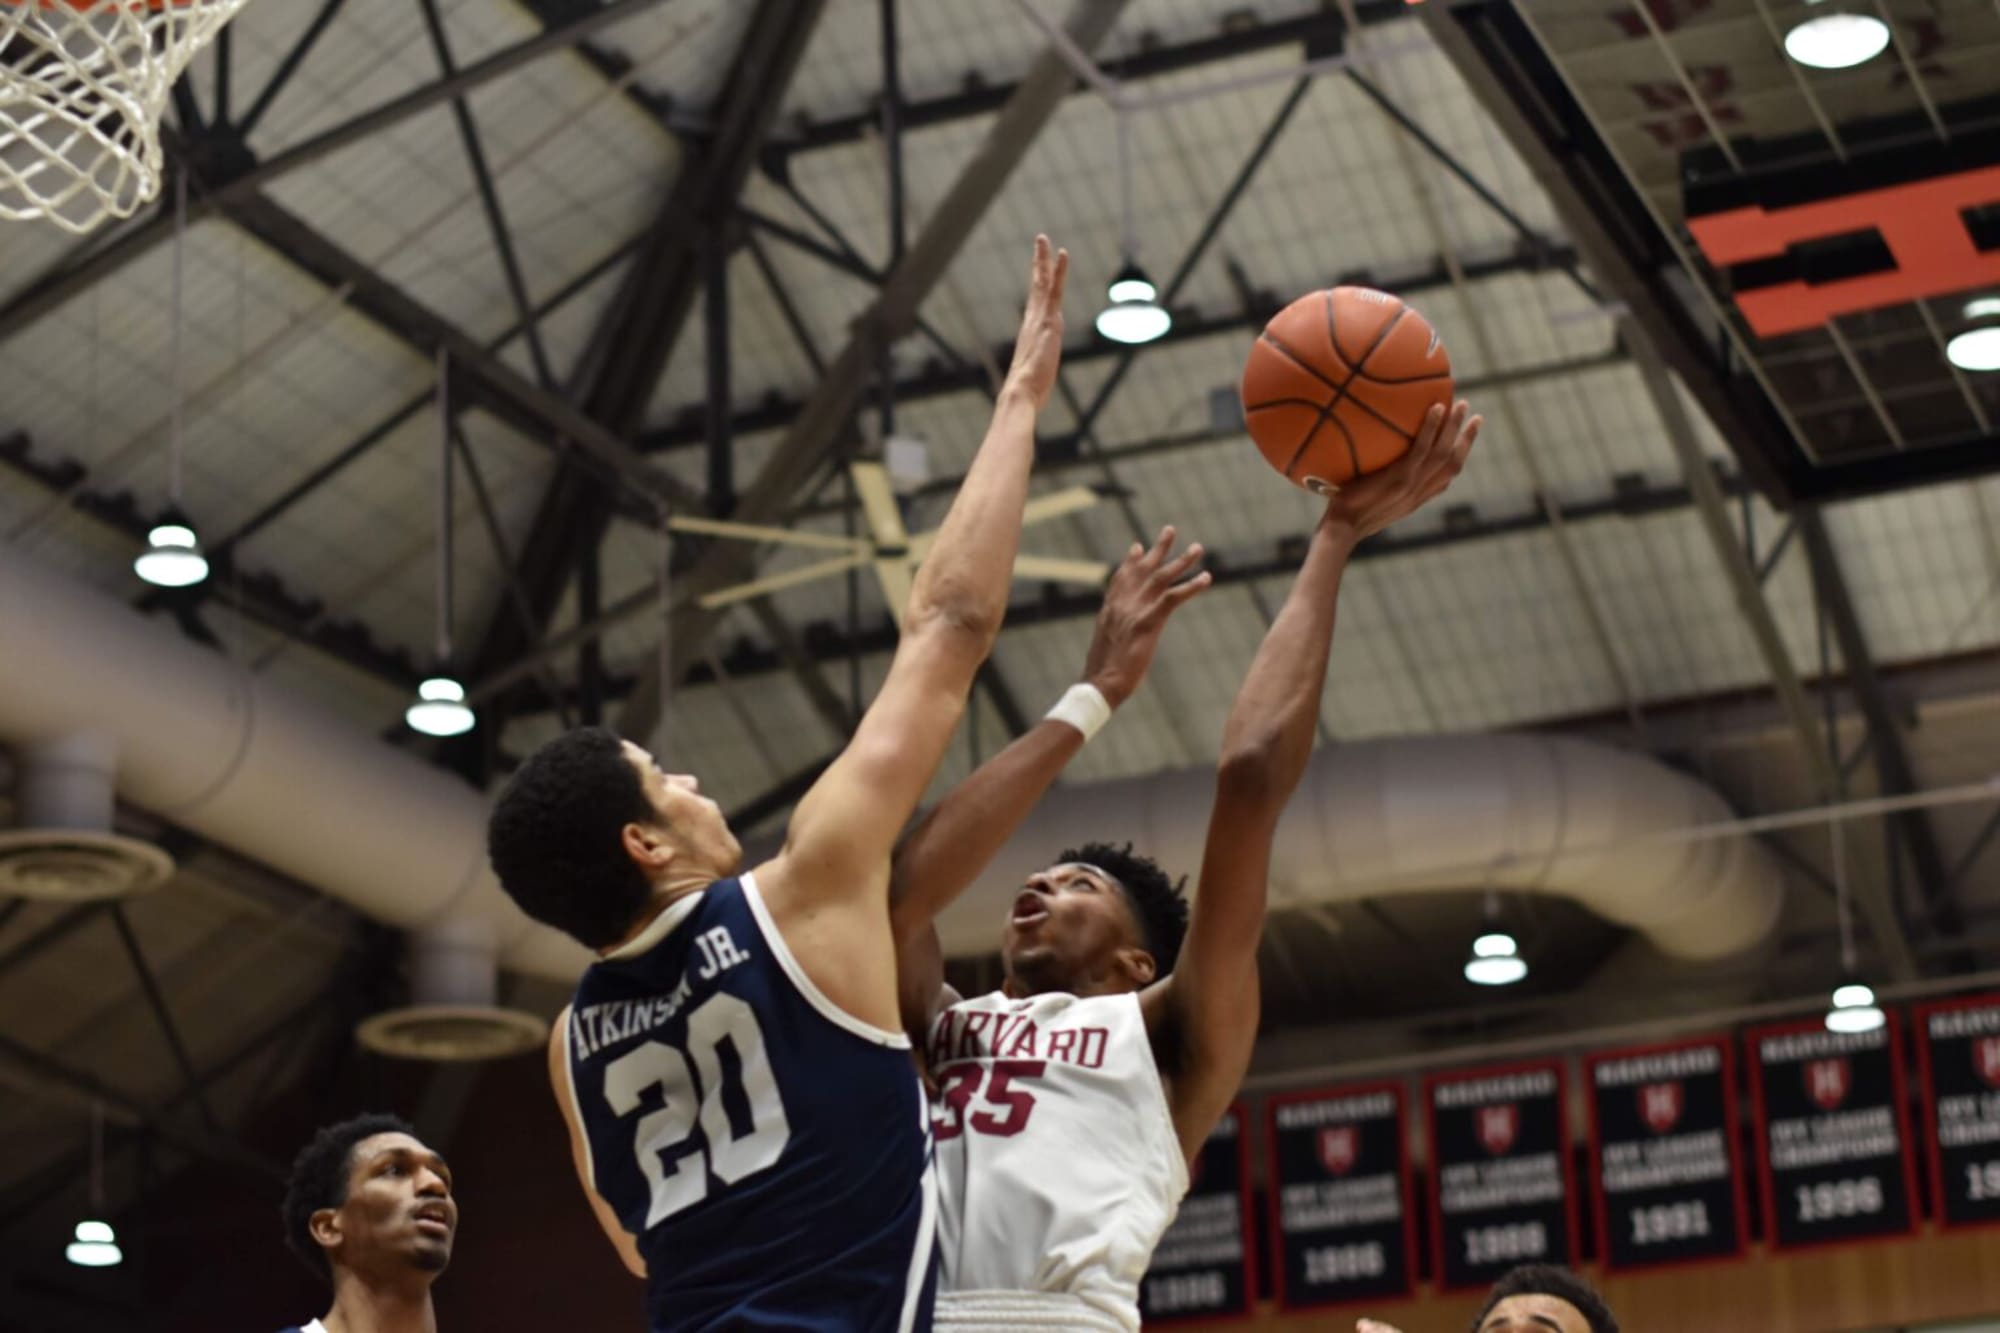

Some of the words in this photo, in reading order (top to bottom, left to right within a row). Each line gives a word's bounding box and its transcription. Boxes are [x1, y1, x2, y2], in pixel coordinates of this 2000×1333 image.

[695, 926, 749, 980] JR.
[932, 1010, 1109, 1069] ARVARD
[1762, 1030, 1884, 1061] HARVARD
[1435, 1072, 1553, 1107] HARVARD
[1597, 1050, 1718, 1084] HARVARD
[604, 992, 791, 1230] 20
[931, 1060, 1047, 1141] 35
[1277, 1097, 1394, 1128] HARVARD
[1631, 1199, 1710, 1245] 1991
[1798, 1177, 1883, 1222] 1996
